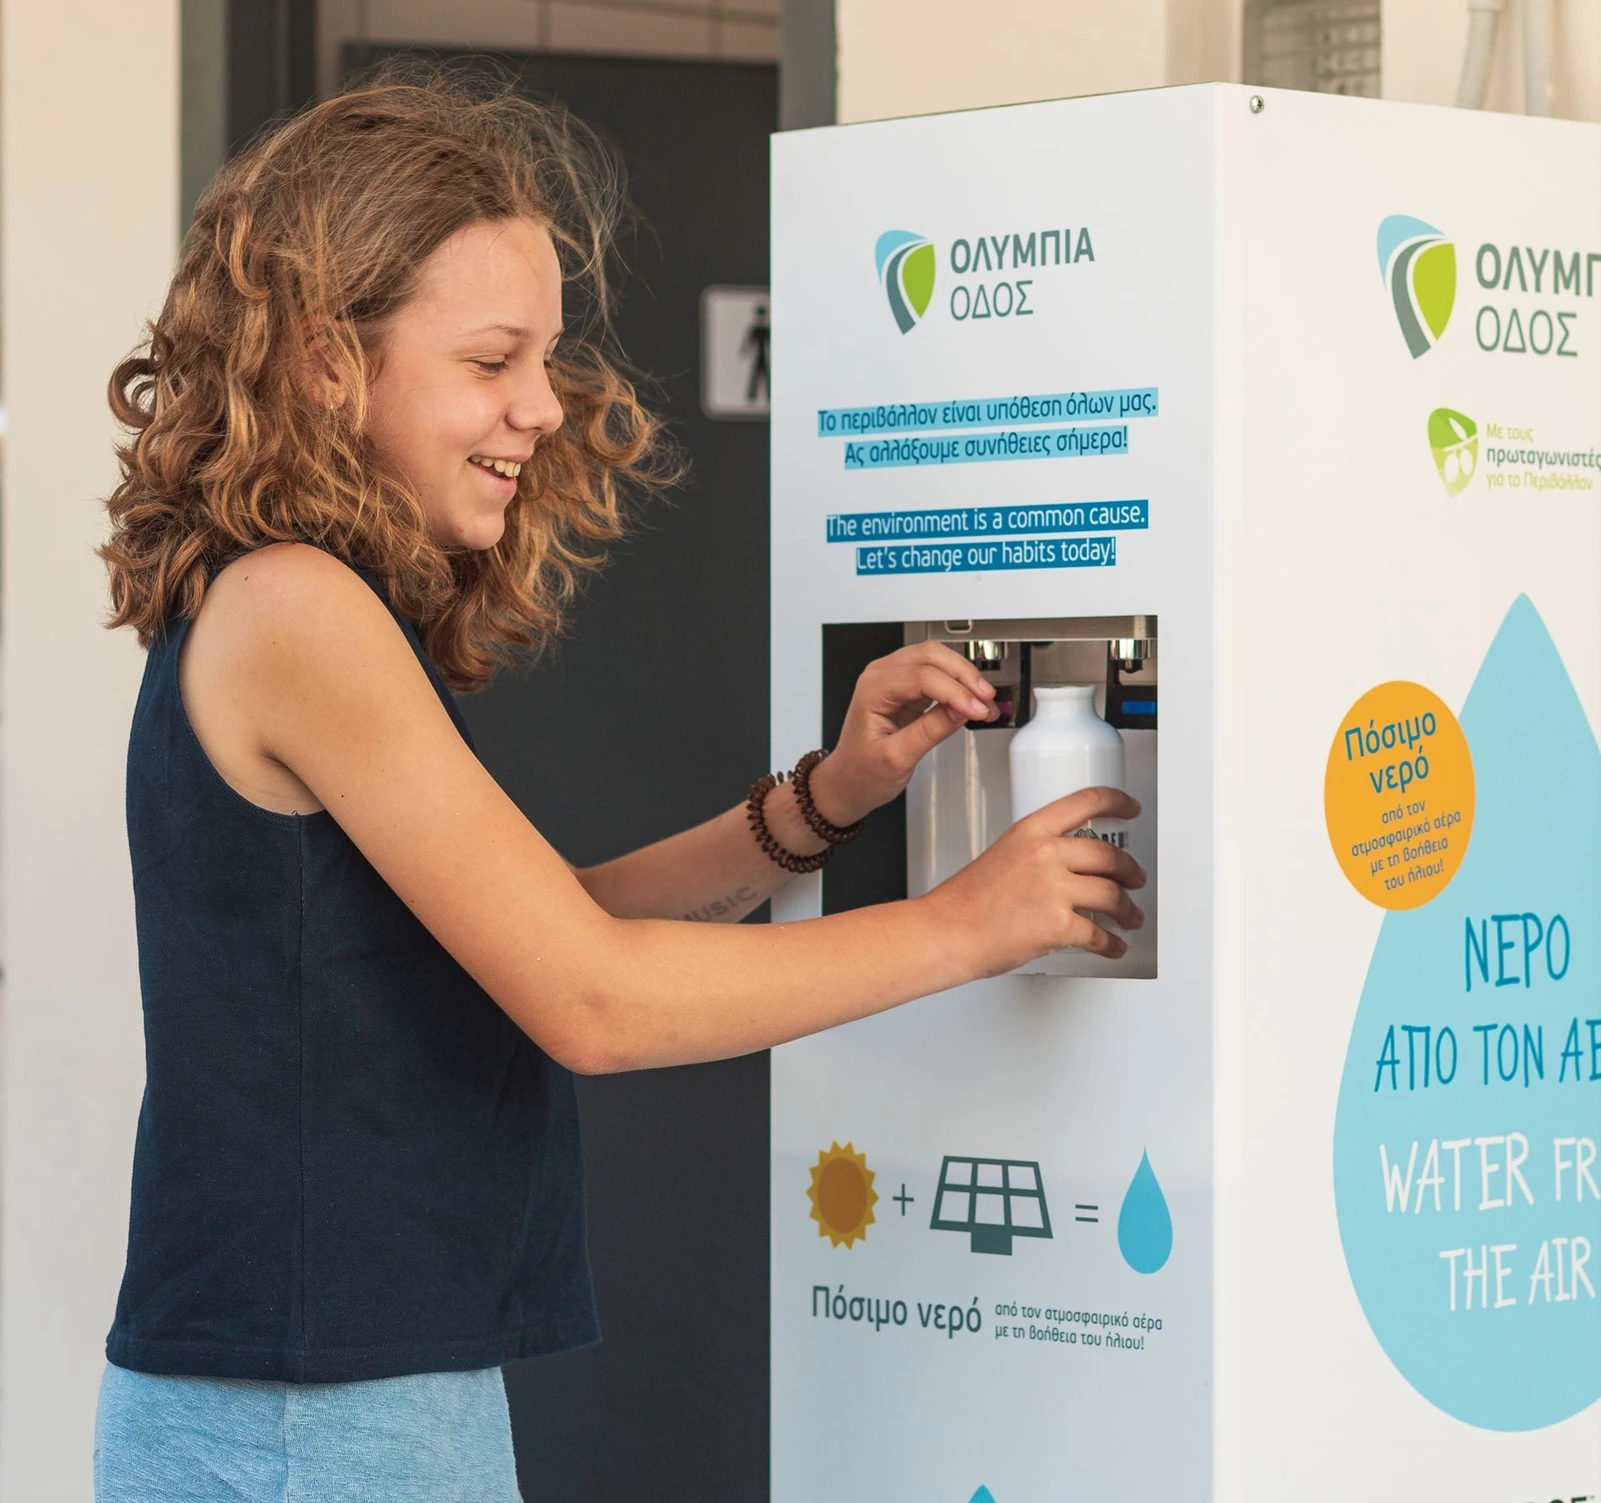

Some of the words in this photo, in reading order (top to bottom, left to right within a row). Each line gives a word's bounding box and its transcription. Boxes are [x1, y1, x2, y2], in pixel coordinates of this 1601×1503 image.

[950, 227, 1095, 274] ΟΛΥΜΠΙΑ
[950, 280, 1034, 321] ΟΔΟΣ
[1476, 305, 1578, 357] ΟΔΟΣ
[818, 410, 837, 432] Το
[841, 405, 937, 434] περιβάλλον
[942, 400, 982, 424] είναι
[986, 396, 1061, 420] υπόθεση
[1066, 392, 1114, 416] όλων
[1119, 391, 1156, 418] μας.
[1486, 423, 1503, 440] Με
[1507, 427, 1534, 444] τους
[845, 444, 864, 467] Ας
[869, 437, 959, 464] αλλάξουμε
[965, 431, 1051, 457] συνήθειες
[1056, 426, 1128, 455] σήμερα!
[826, 514, 857, 538] The
[862, 511, 968, 536] environment
[974, 509, 988, 531] is
[993, 513, 1003, 530] a
[1007, 506, 1084, 529] common
[1089, 503, 1146, 526] cause.
[856, 545, 897, 570] Let's
[901, 542, 962, 573] change
[967, 546, 998, 565] our
[1002, 540, 1056, 564] habits
[1061, 538, 1116, 565] today!
[1344, 712, 1437, 761] Πόσιμο
[1369, 746, 1430, 794] νερό
[1381, 803, 1404, 824] από
[1406, 800, 1426, 816] τον
[1351, 817, 1431, 857] ατμοσφαιρικό
[1434, 811, 1461, 829] αέρα
[1370, 859, 1384, 877] με
[1387, 854, 1400, 867] τη
[1403, 838, 1449, 862] βοήθεια
[1384, 875, 1405, 891] του
[1408, 858, 1444, 883] ήλιου!
[1465, 912, 1571, 993] ΝΕΡΟ
[1374, 1023, 1458, 1092] ΑΠΟ
[1473, 1023, 1545, 1088] ΤΟΝ
[1379, 1131, 1535, 1215] WATER
[1439, 1243, 1518, 1312] THE
[1528, 1236, 1597, 1307] AIR
[812, 1284, 908, 1332] Πόσιμο
[917, 1296, 982, 1339] νερό
[995, 1301, 1018, 1317] από
[1021, 1306, 1041, 1319] τον
[1045, 1308, 1129, 1328] ατμοσφαιρικό
[1132, 1313, 1163, 1333] αέρα
[995, 1325, 1009, 1340] με
[1012, 1326, 1026, 1339] τη
[1029, 1325, 1077, 1344] βοήθεια
[1080, 1333, 1102, 1346] του
[1105, 1331, 1145, 1350] ήλιου!
